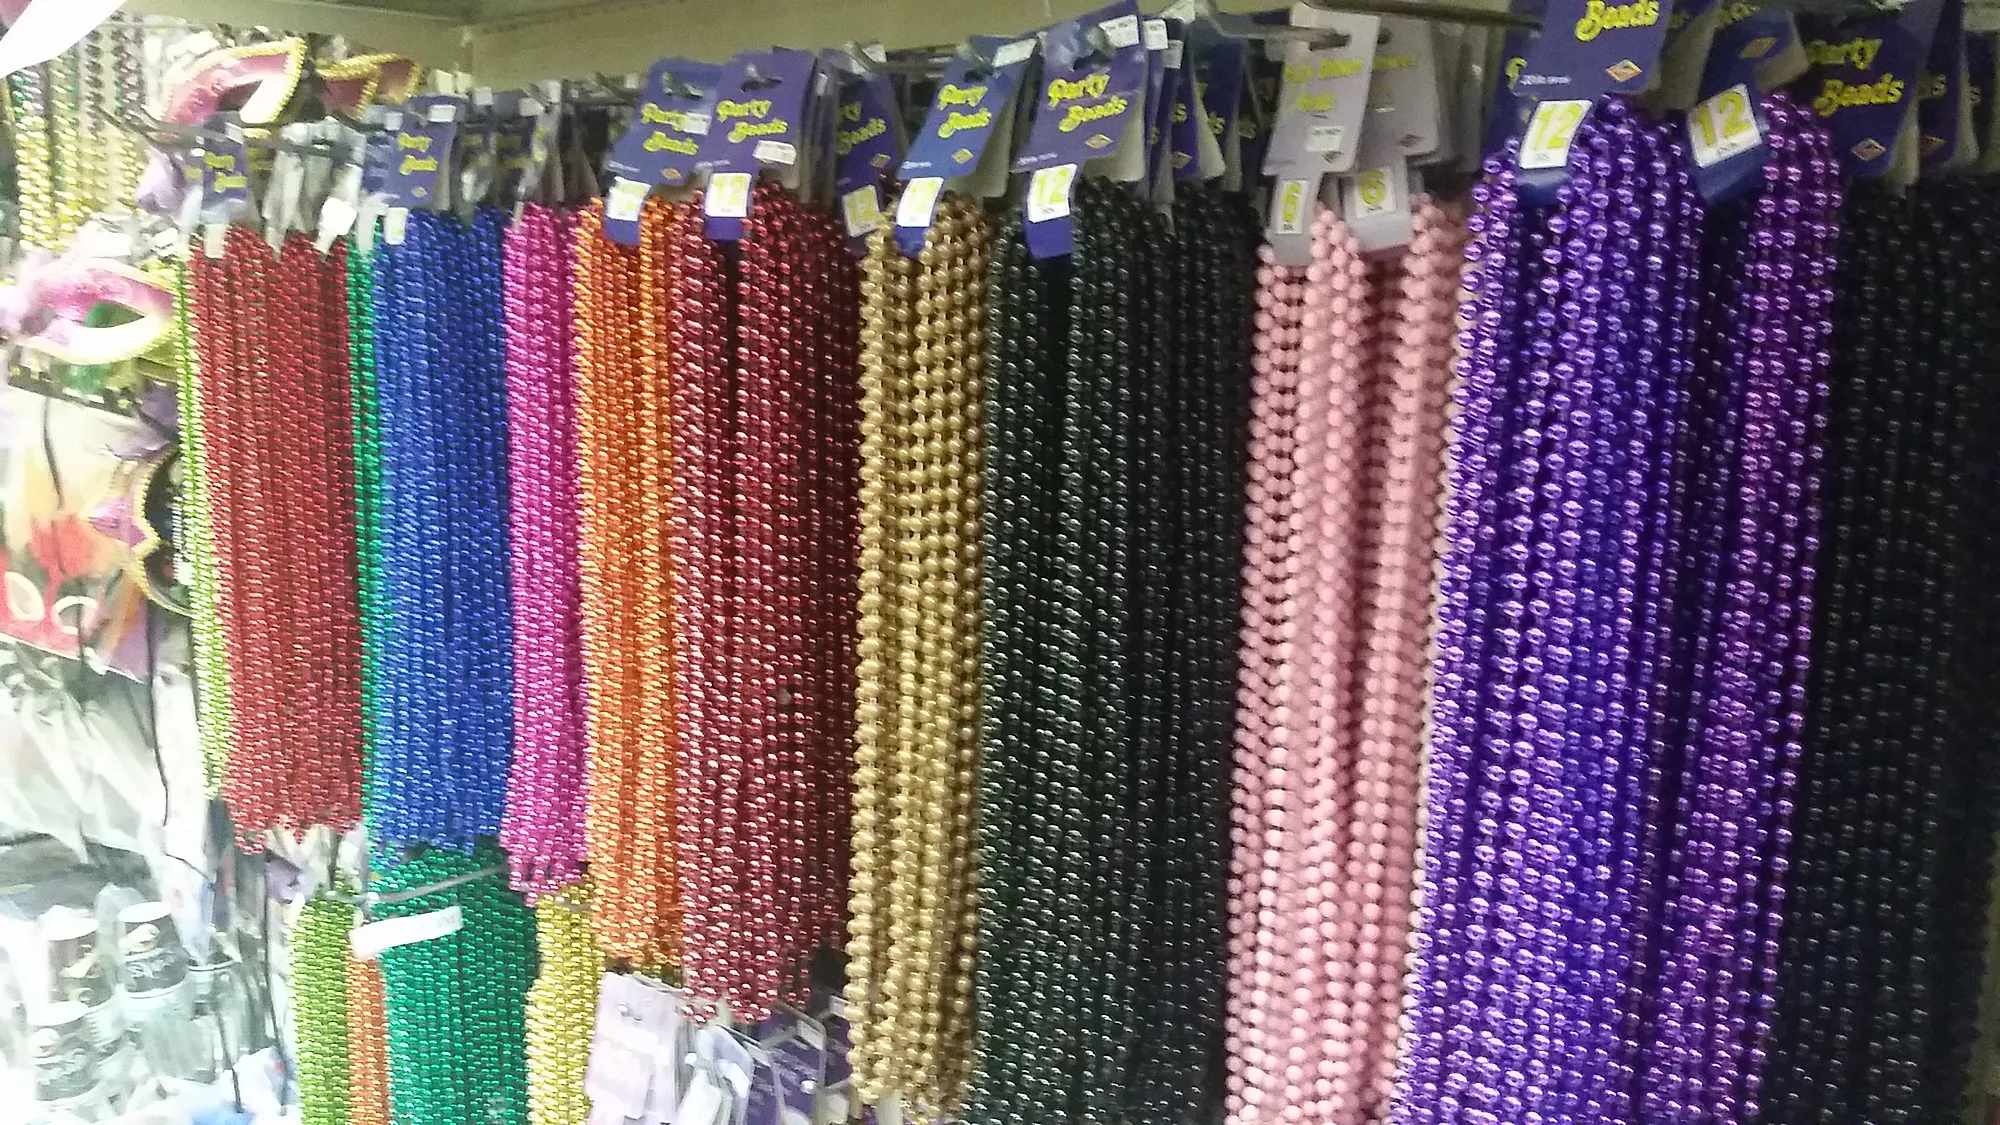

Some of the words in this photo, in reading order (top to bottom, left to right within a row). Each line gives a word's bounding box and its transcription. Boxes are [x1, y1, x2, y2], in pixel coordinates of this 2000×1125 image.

[1575, 0, 1660, 42] Beads
[1047, 74, 1111, 108] Party
[1814, 73, 1905, 118] Beads
[716, 100, 772, 123] Party
[1058, 95, 1129, 132] Beads
[1534, 102, 1585, 149] 12
[1694, 91, 1751, 146] 12
[727, 118, 788, 144] Beads
[712, 175, 747, 206] 12
[1036, 167, 1069, 206] 12
[1362, 170, 1386, 207] 6
